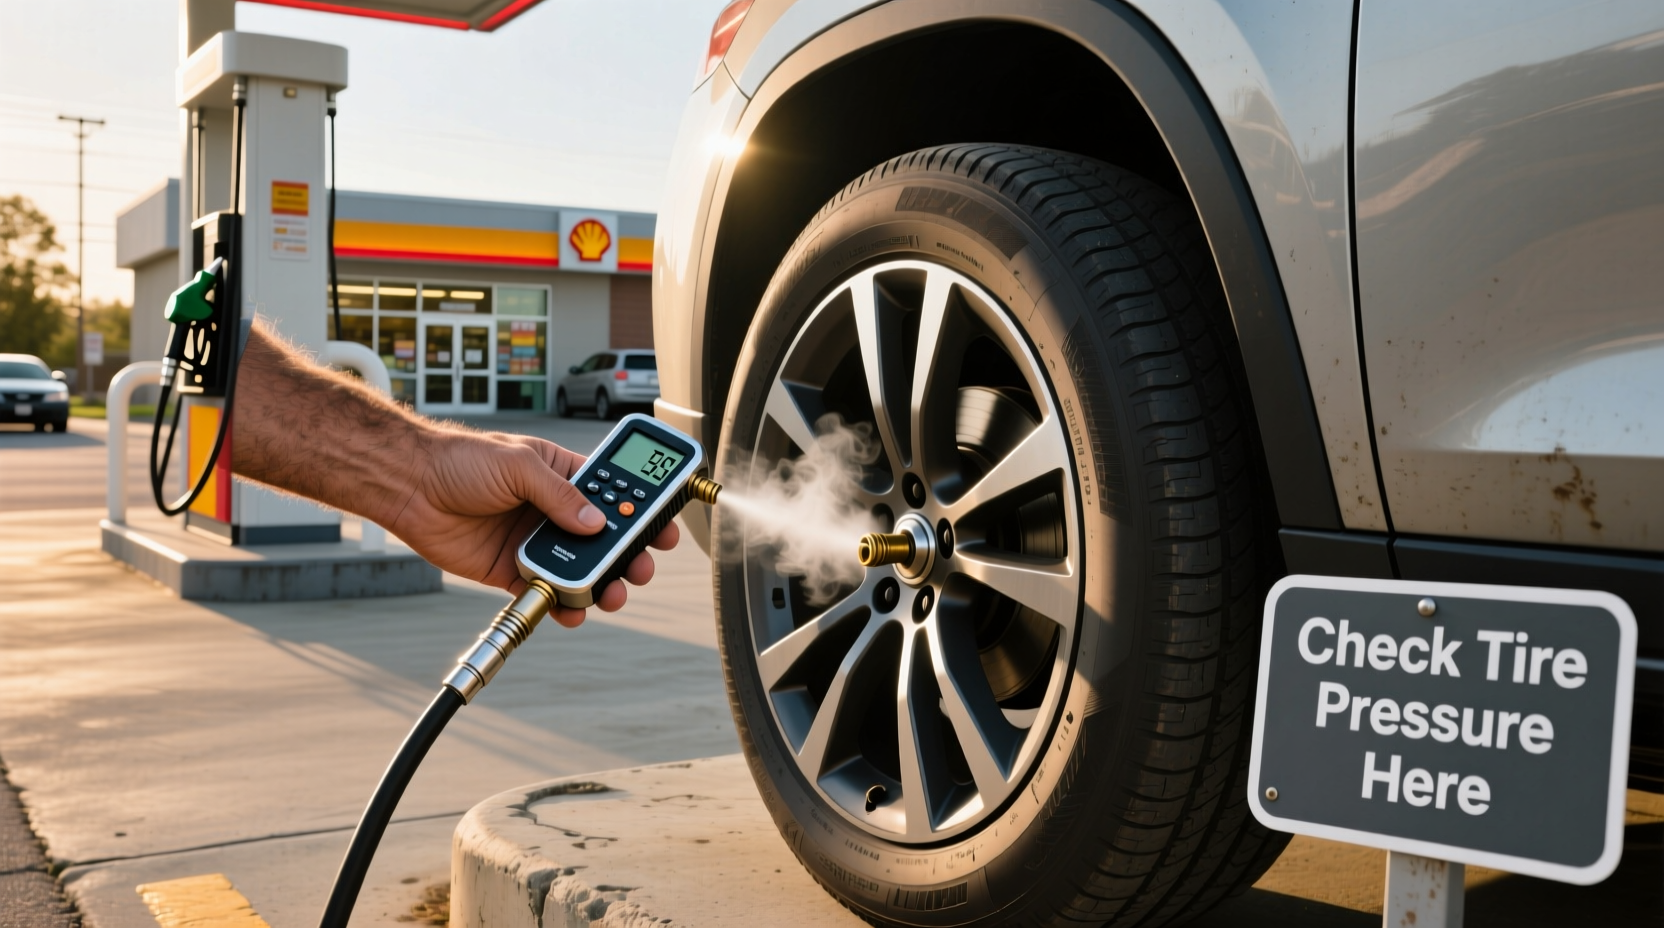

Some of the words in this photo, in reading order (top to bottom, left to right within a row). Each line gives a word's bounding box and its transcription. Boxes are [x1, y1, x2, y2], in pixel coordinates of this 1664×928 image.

[1297, 616, 1463, 678] Check
[1476, 629, 1588, 689] Tire
[1315, 681, 1554, 755] Pressure
[1361, 751, 1491, 816] Here
